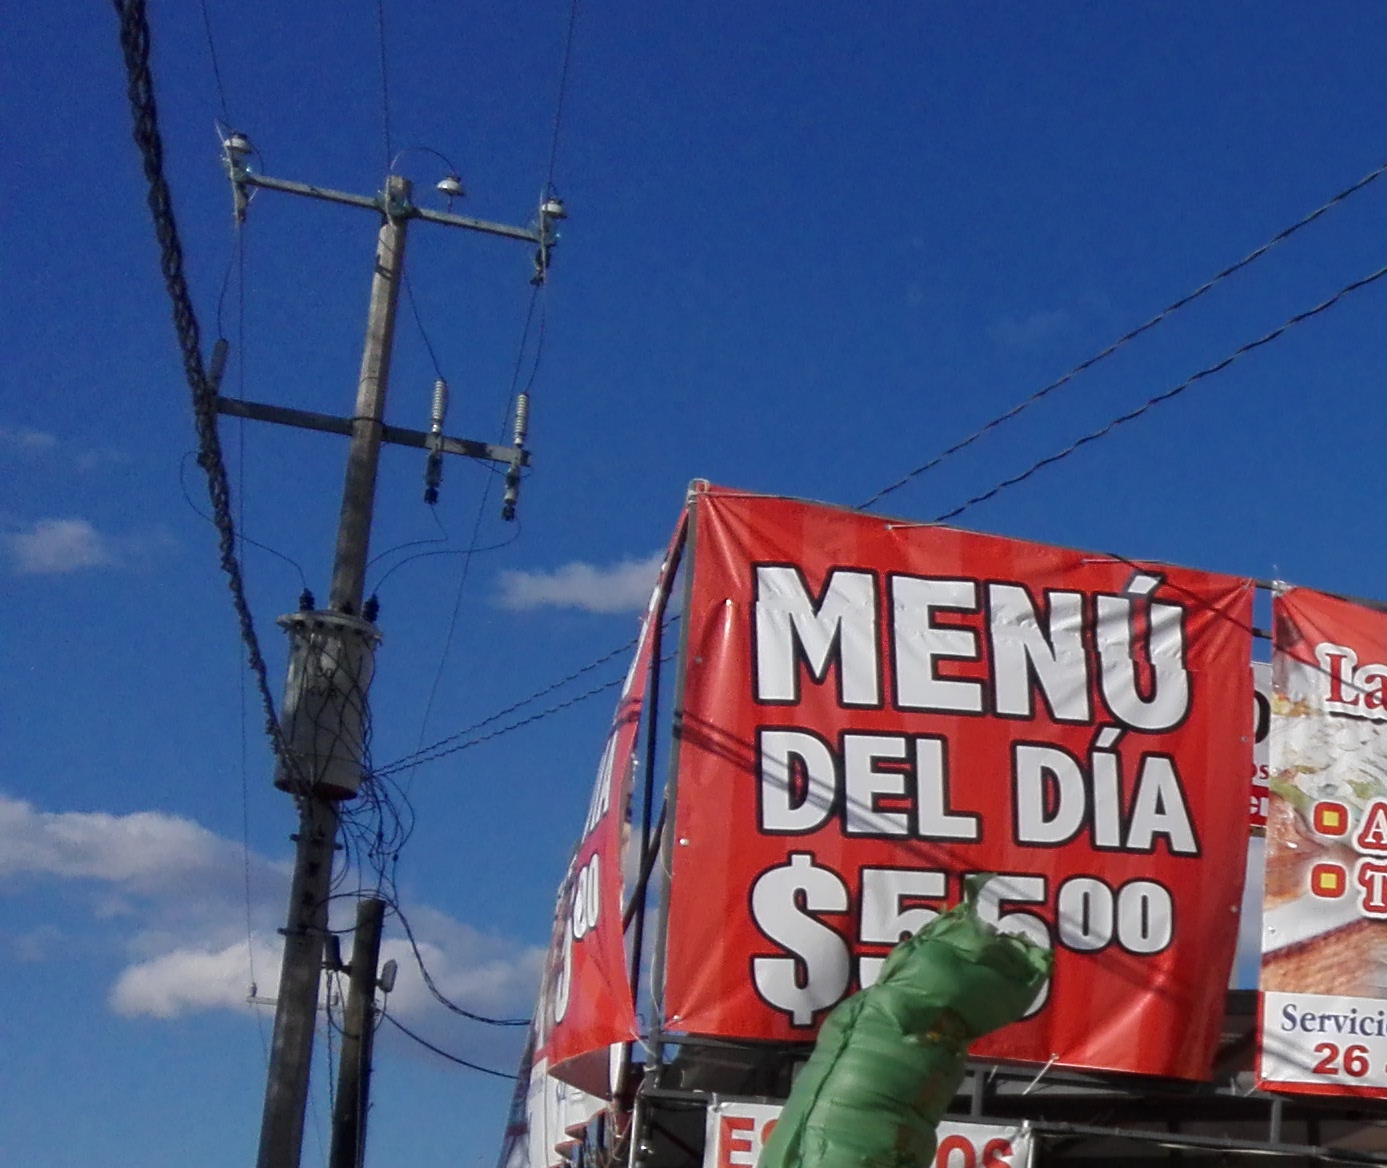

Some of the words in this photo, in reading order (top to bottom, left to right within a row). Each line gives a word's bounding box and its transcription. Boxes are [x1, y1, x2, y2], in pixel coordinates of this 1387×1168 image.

[756, 566, 1190, 730] MENÚ
[761, 730, 979, 839] DEL
[1016, 730, 1198, 854] DÍA
[1312, 1042, 1370, 1078] 26
